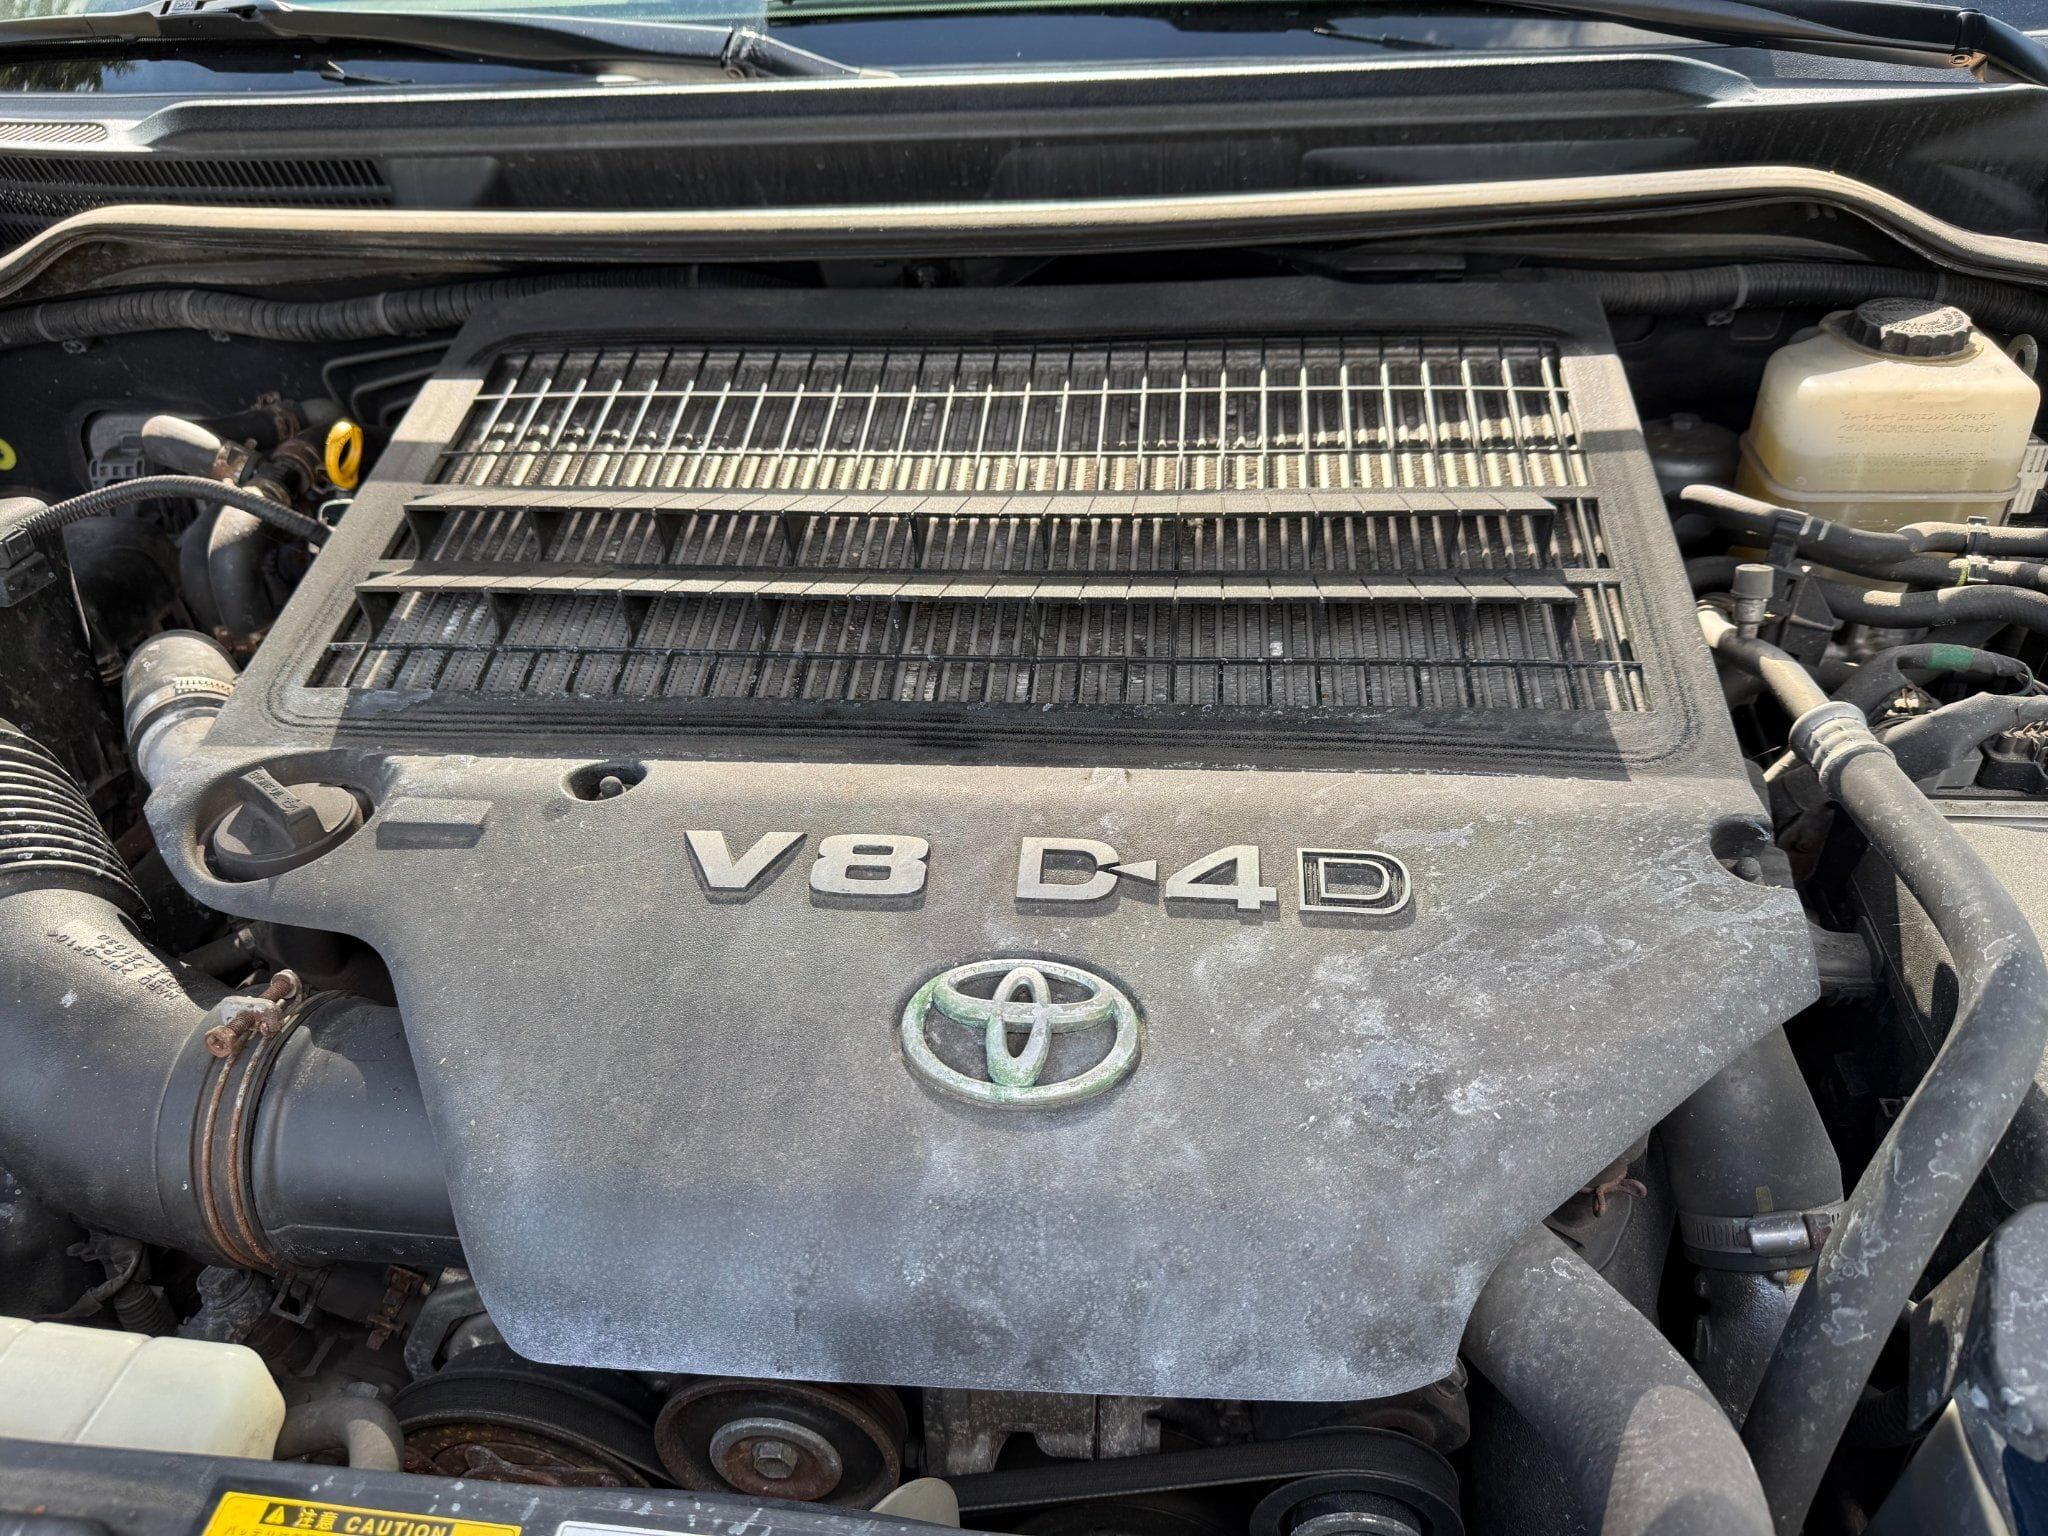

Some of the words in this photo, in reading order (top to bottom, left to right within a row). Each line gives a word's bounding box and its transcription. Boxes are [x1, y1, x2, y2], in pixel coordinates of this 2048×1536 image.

[685, 829, 929, 898] V8
[138, 976, 180, 1001] HARD
[293, 1506, 338, 1530] 注意
[344, 1515, 448, 1536] CAUTION
